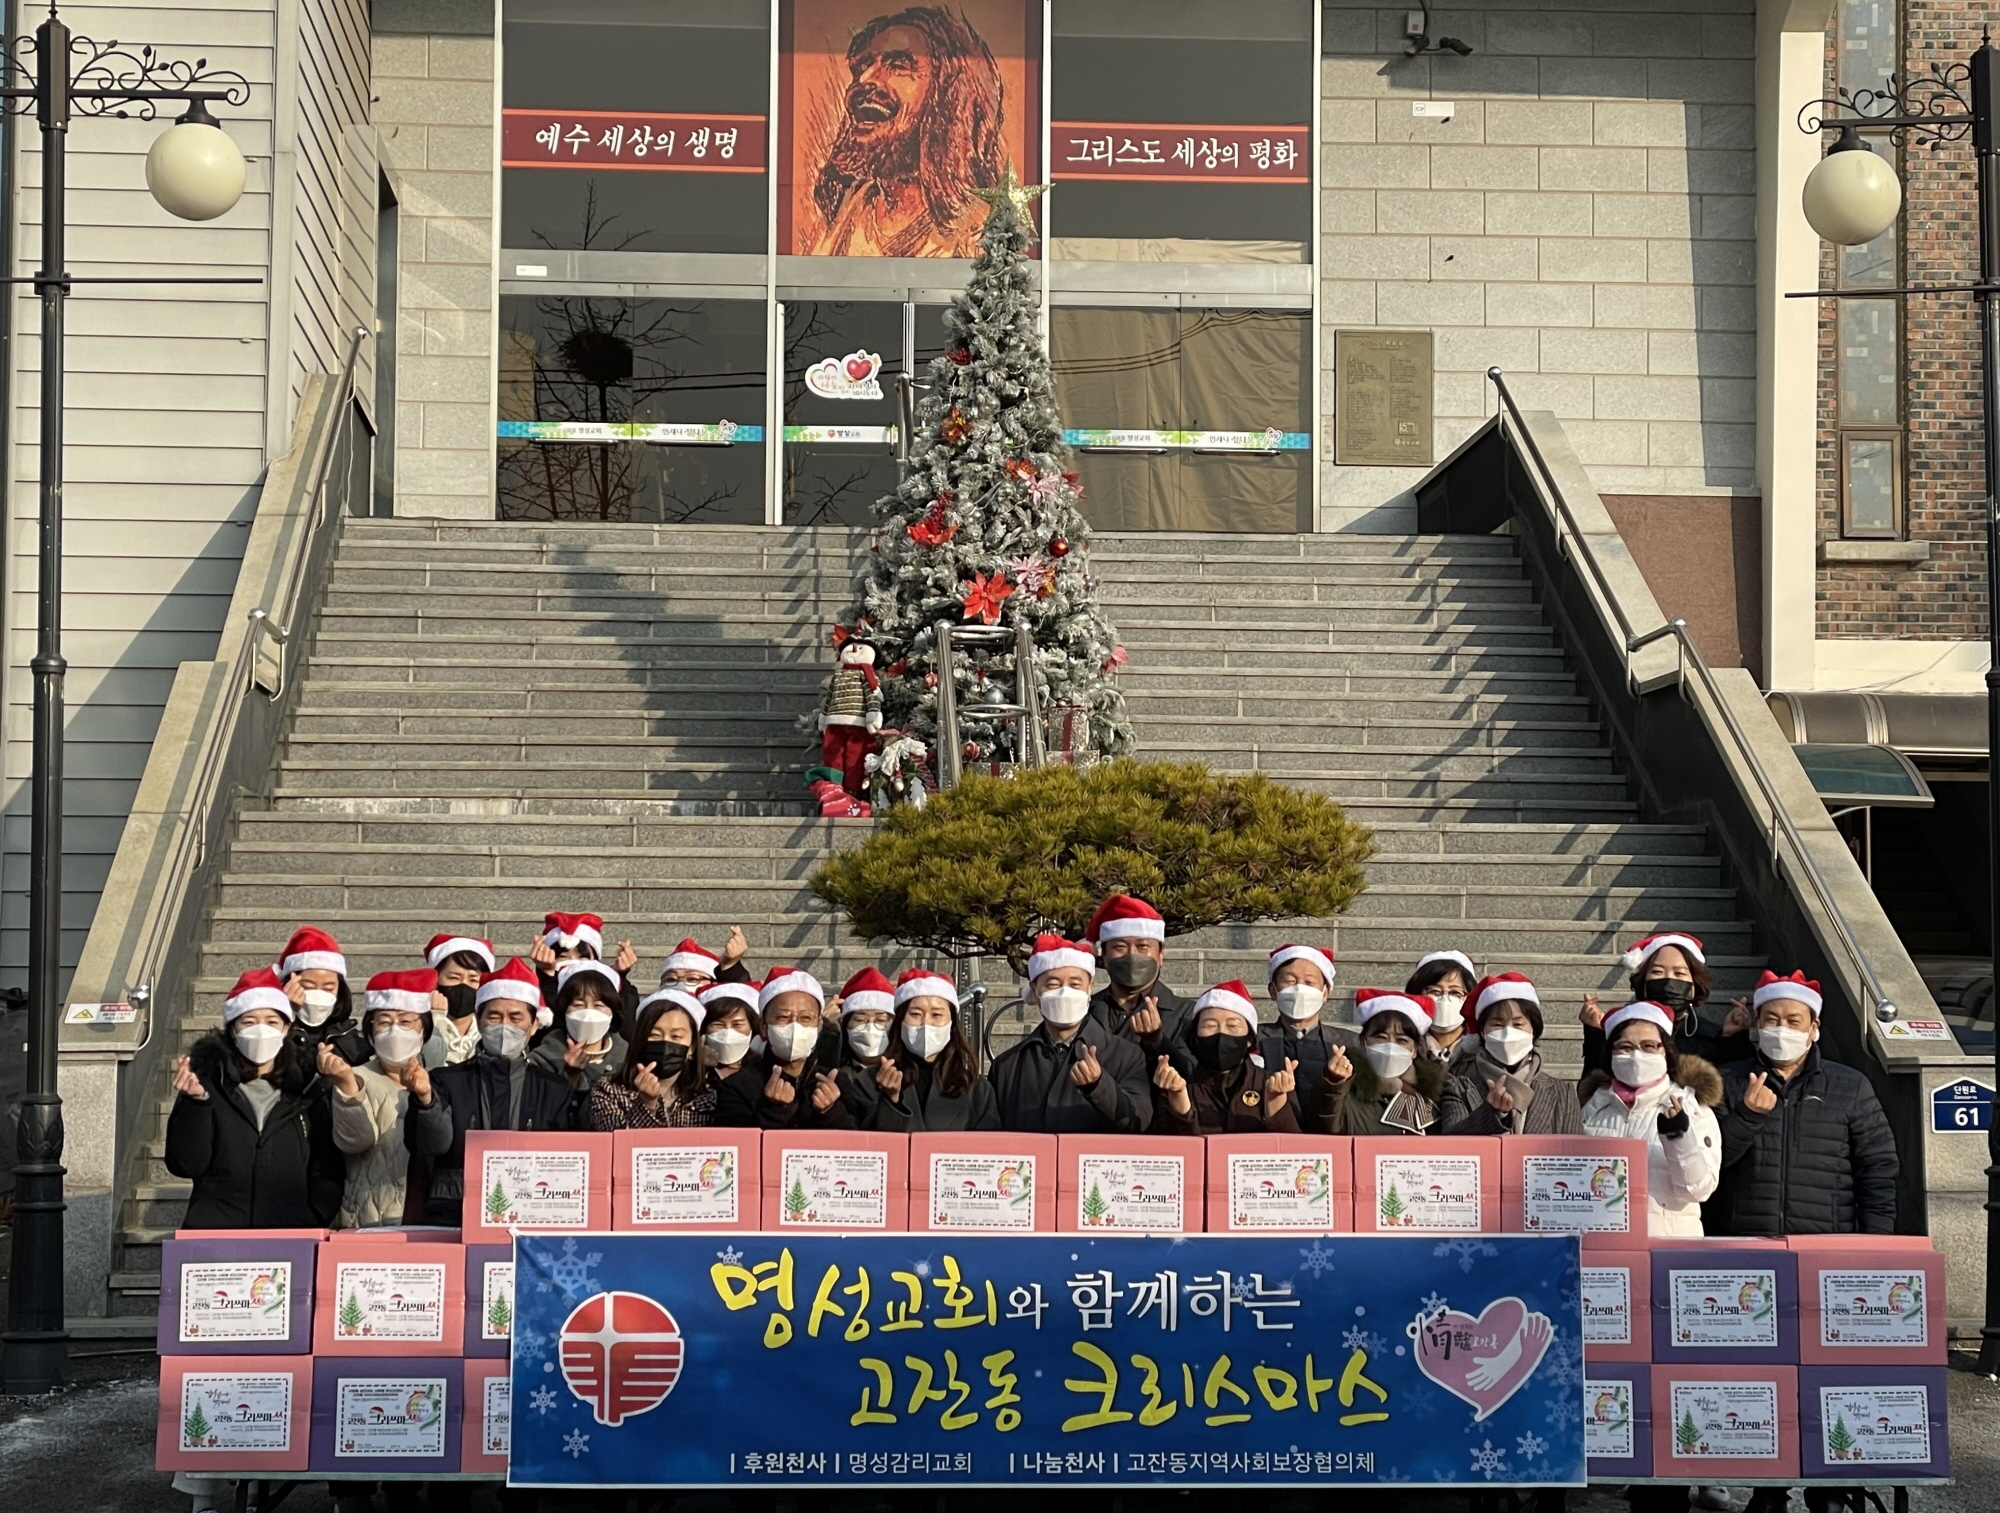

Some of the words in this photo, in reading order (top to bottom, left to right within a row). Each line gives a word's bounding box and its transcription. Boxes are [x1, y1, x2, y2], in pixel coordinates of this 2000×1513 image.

[535, 122, 591, 155] 예수
[596, 124, 676, 157] 세상의
[684, 126, 738, 159] 생명
[1066, 136, 1166, 167] 그리스도
[1171, 137, 1239, 169] 세상의
[1249, 139, 1299, 170] 평화
[1954, 1085, 1977, 1094] 단원로
[1955, 1107, 1979, 1126] 61
[710, 1247, 1048, 1349] 명성교회와
[1066, 1269, 1300, 1332] 함께하는
[1472, 1333, 1499, 1350] 고잔동
[850, 1349, 1022, 1433] 고잔동
[1062, 1341, 1389, 1433] 크리스마스
[742, 1453, 828, 1474] 후원천사
[848, 1452, 973, 1474] 명성감리교회
[1022, 1453, 1105, 1474] 나눔천사
[1126, 1452, 1376, 1475] 고잔동지역사회보장협의체
